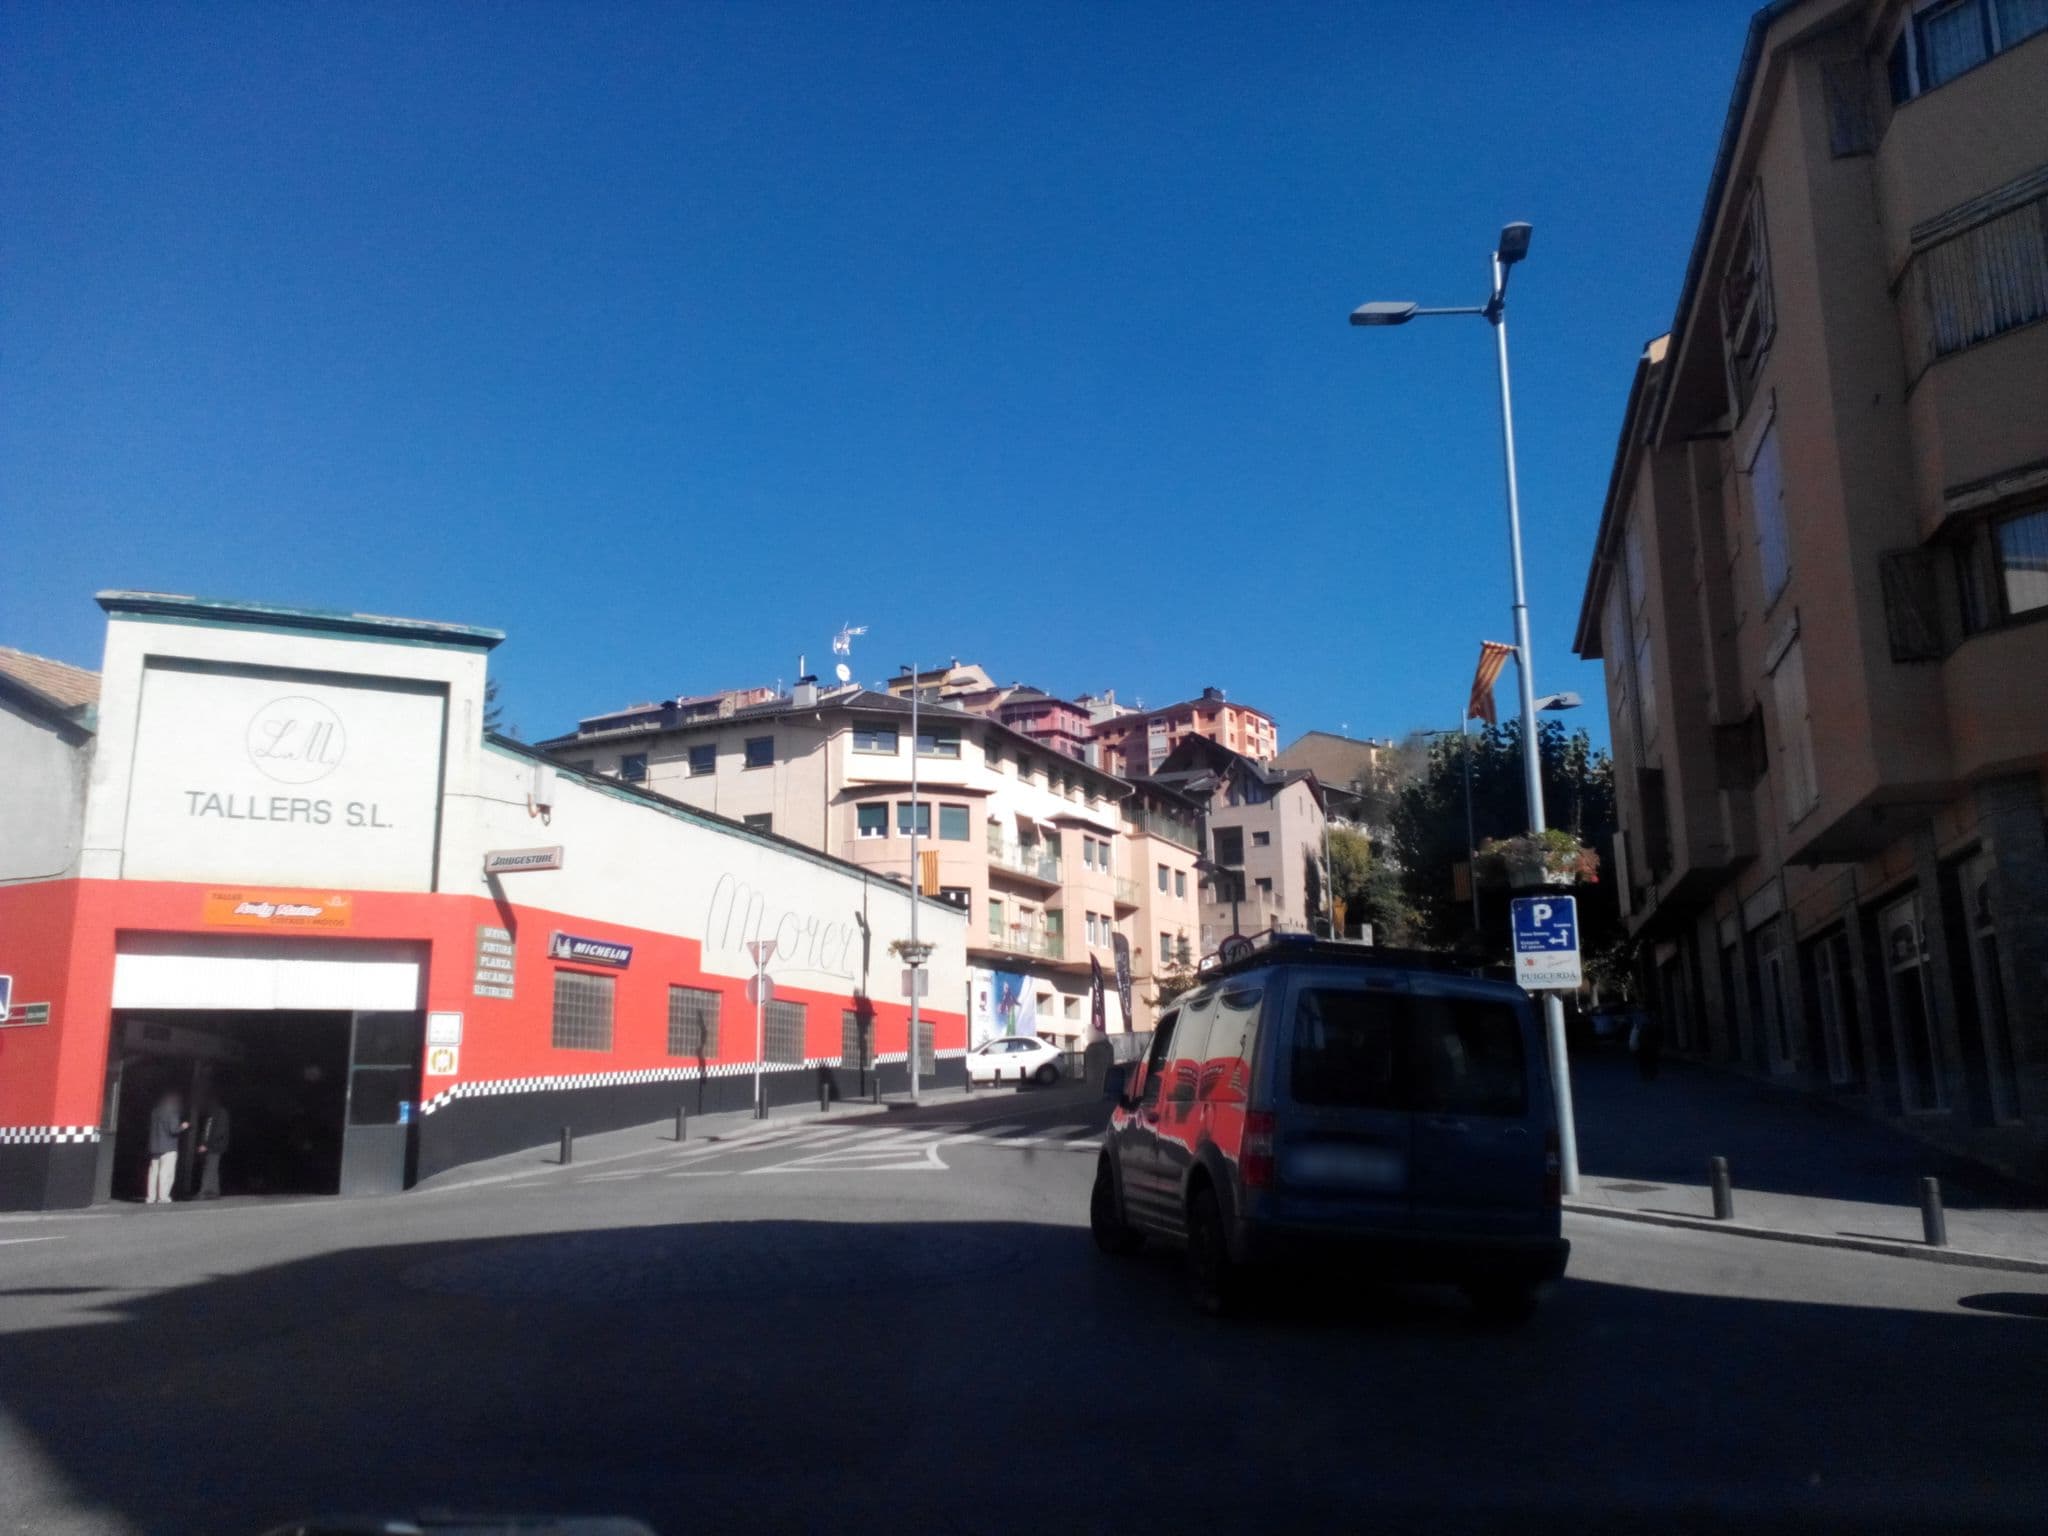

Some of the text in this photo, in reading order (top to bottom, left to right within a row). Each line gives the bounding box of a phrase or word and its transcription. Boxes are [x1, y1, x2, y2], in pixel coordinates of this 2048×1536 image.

[184, 790, 394, 828] TALLERS S.L.
[491, 854, 554, 866] BRIDGESTONE
[1533, 904, 1553, 928] P
[573, 943, 630, 961] MICHELIN
